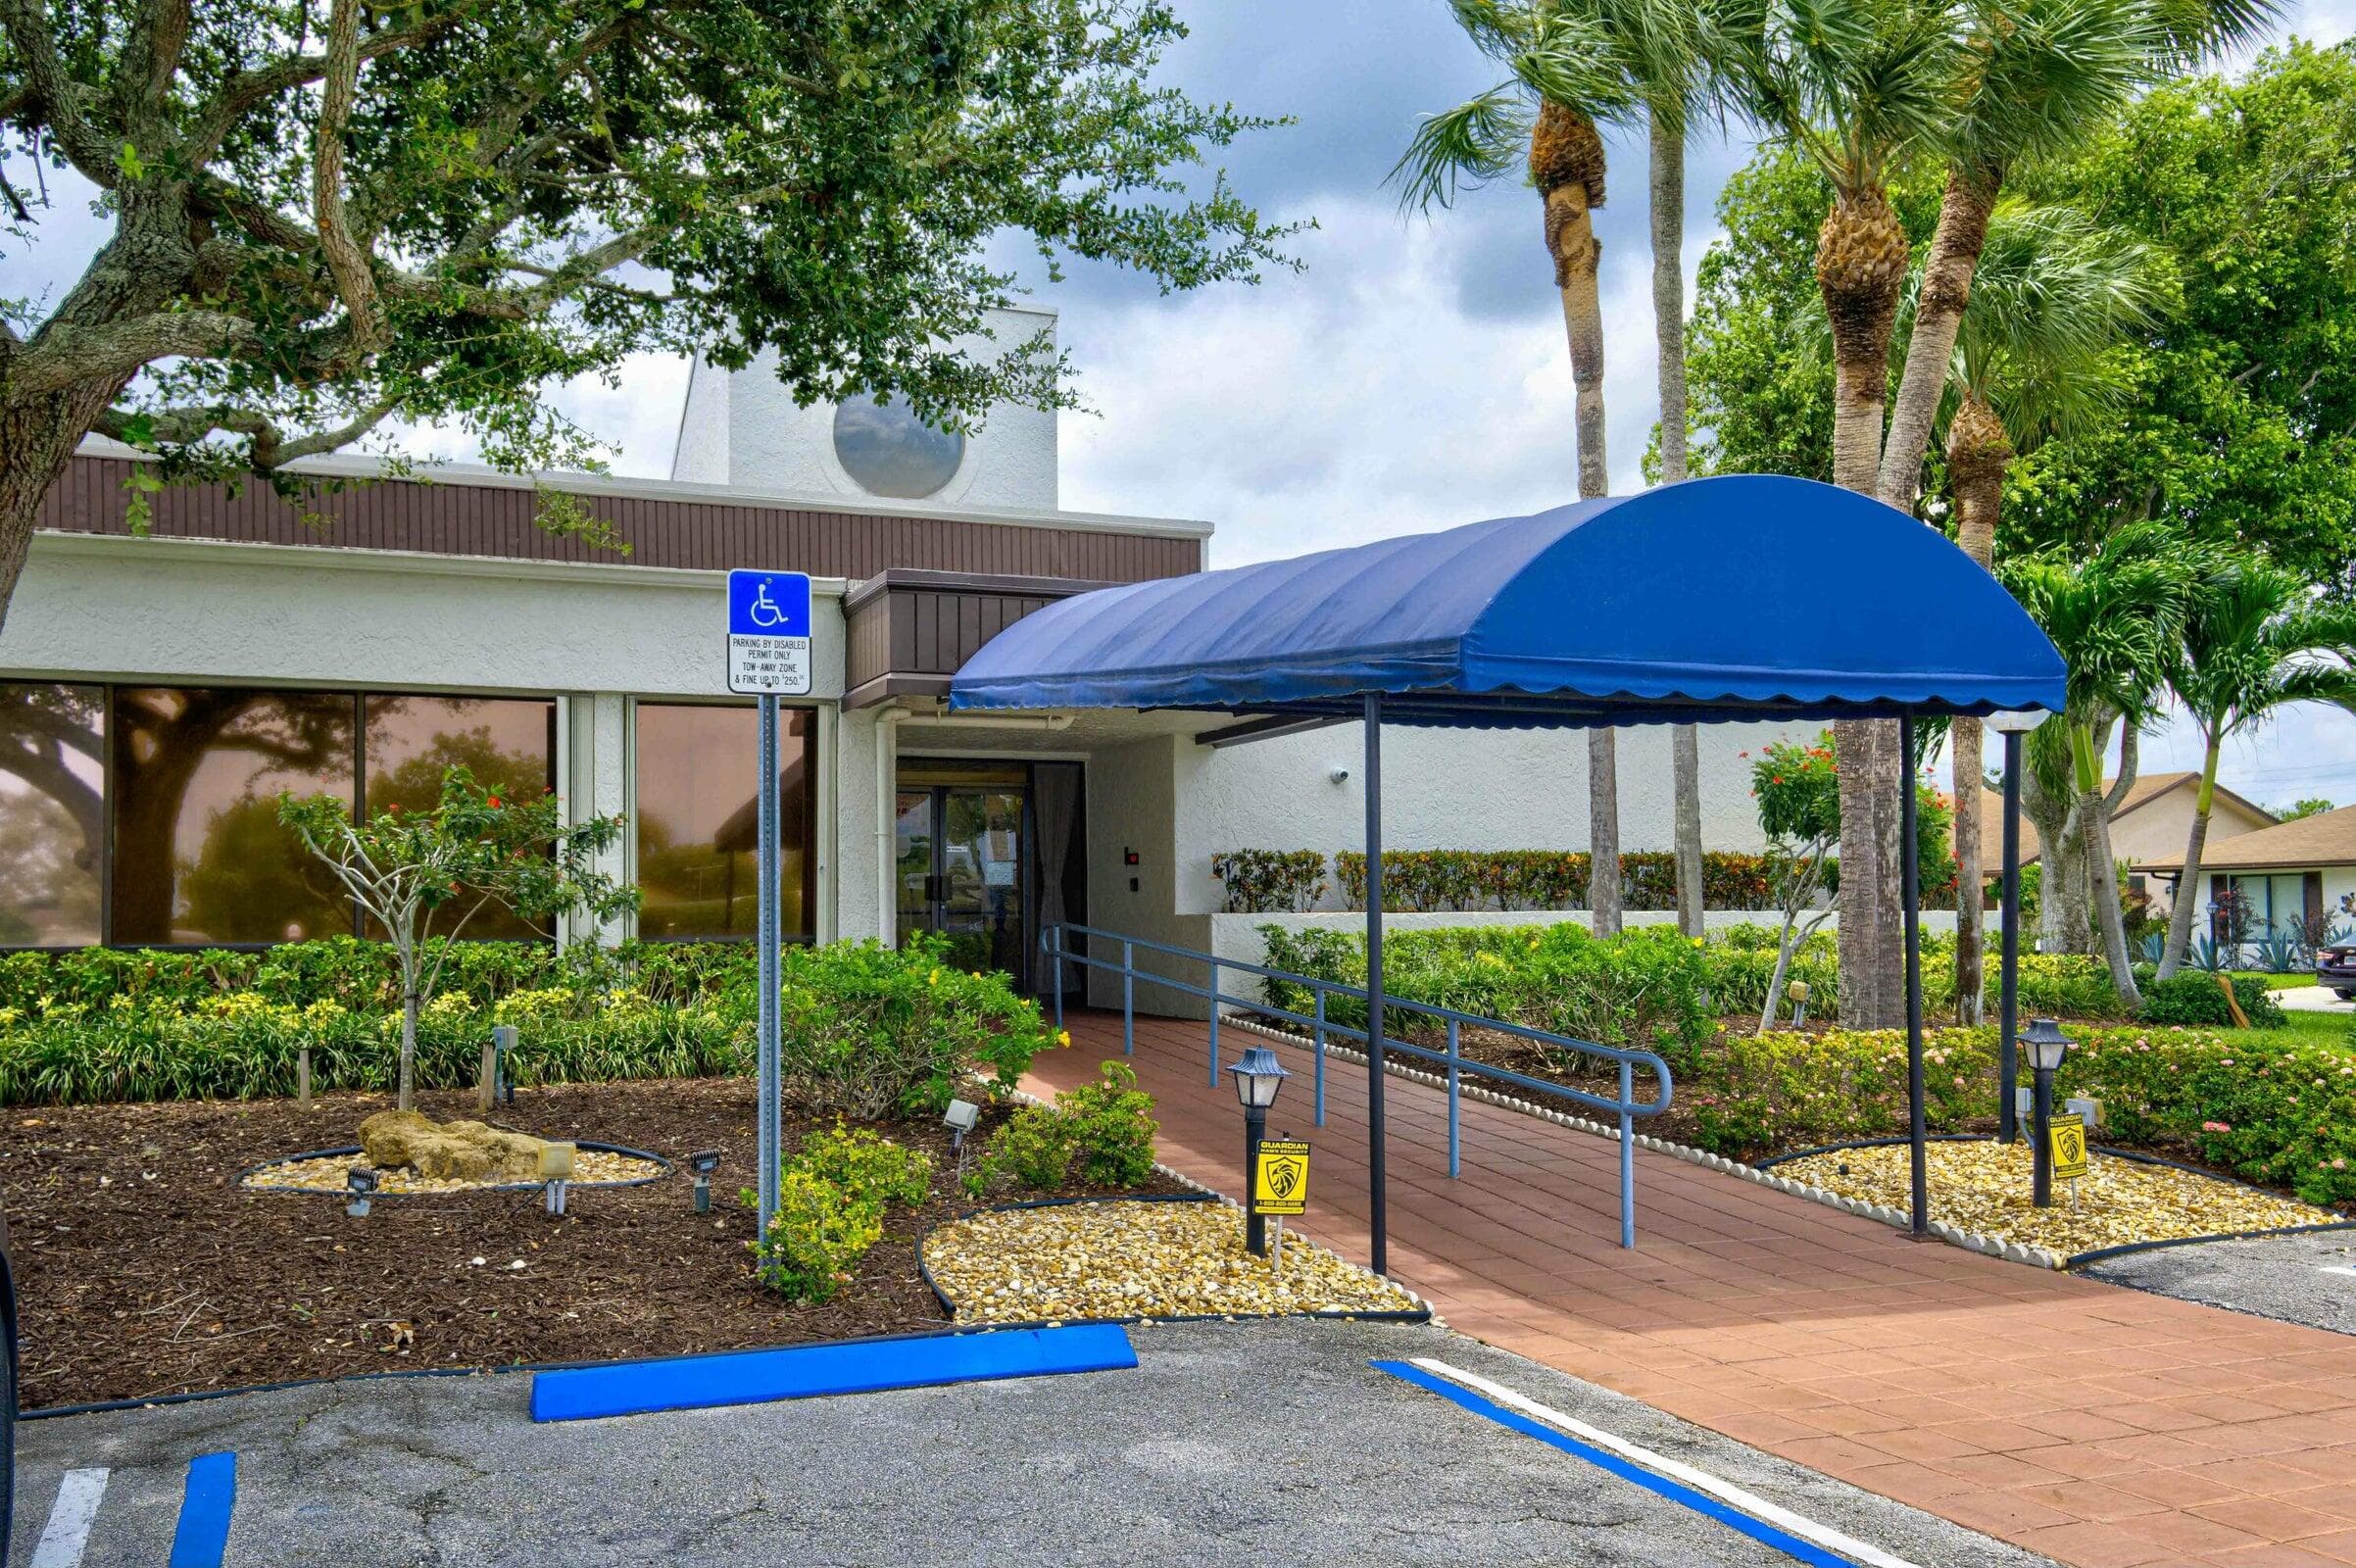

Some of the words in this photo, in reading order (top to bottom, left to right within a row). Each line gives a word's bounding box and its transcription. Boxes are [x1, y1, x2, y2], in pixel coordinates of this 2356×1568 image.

[733, 638, 761, 648] PARKING
[763, 639, 772, 649] BY
[774, 640, 806, 650] DISABLED
[748, 650, 771, 660] PERMIT
[774, 650, 791, 660] ONLY
[742, 662, 776, 672] TOW-AWAY
[779, 663, 797, 672] ZONE
[734, 674, 740, 684] &
[742, 674, 758, 684] FINE
[760, 675, 769, 685] UP
[771, 675, 780, 685] TO
[1260, 1141, 1308, 1150] GUARDIAN
